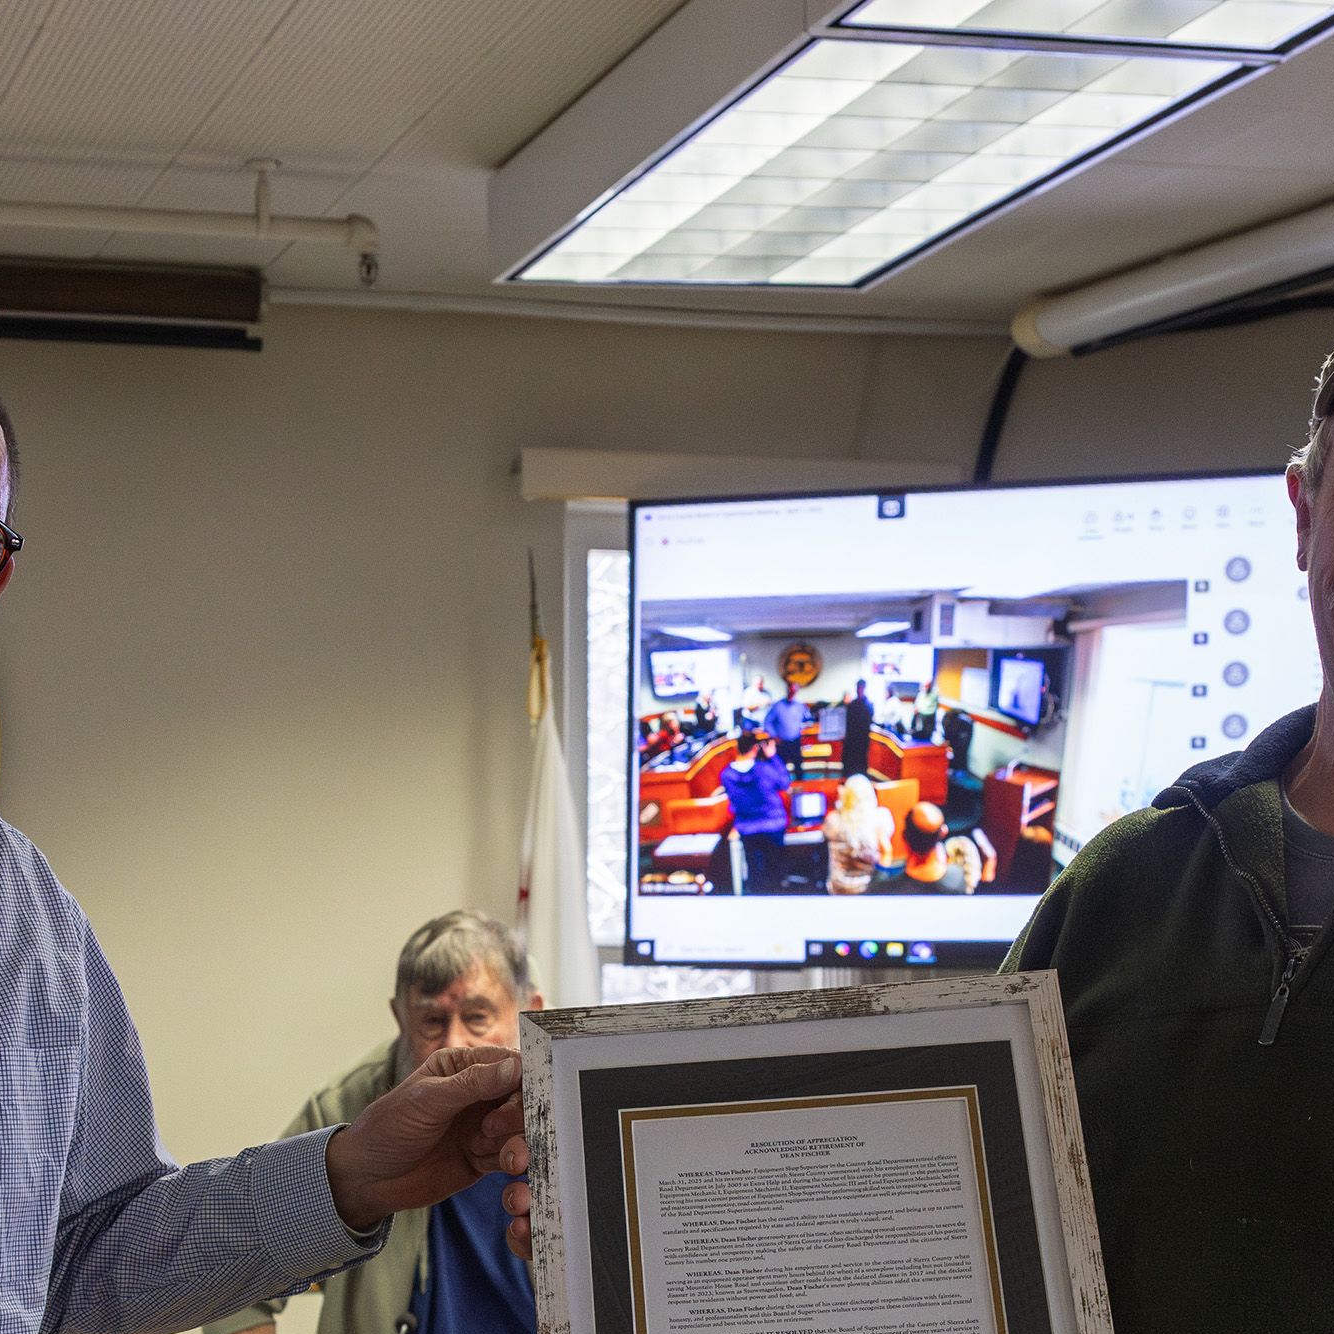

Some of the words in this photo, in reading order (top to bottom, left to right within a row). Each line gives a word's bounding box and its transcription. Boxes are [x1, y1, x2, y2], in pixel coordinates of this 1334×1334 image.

[751, 1140, 795, 1148] RESOLUTION
[807, 1135, 858, 1144] APPRECIATION
[744, 1145, 808, 1155] ACKNOWLEDGING
[809, 1142, 854, 1151] RETIREMENT
[801, 1150, 830, 1158] FISCHER
